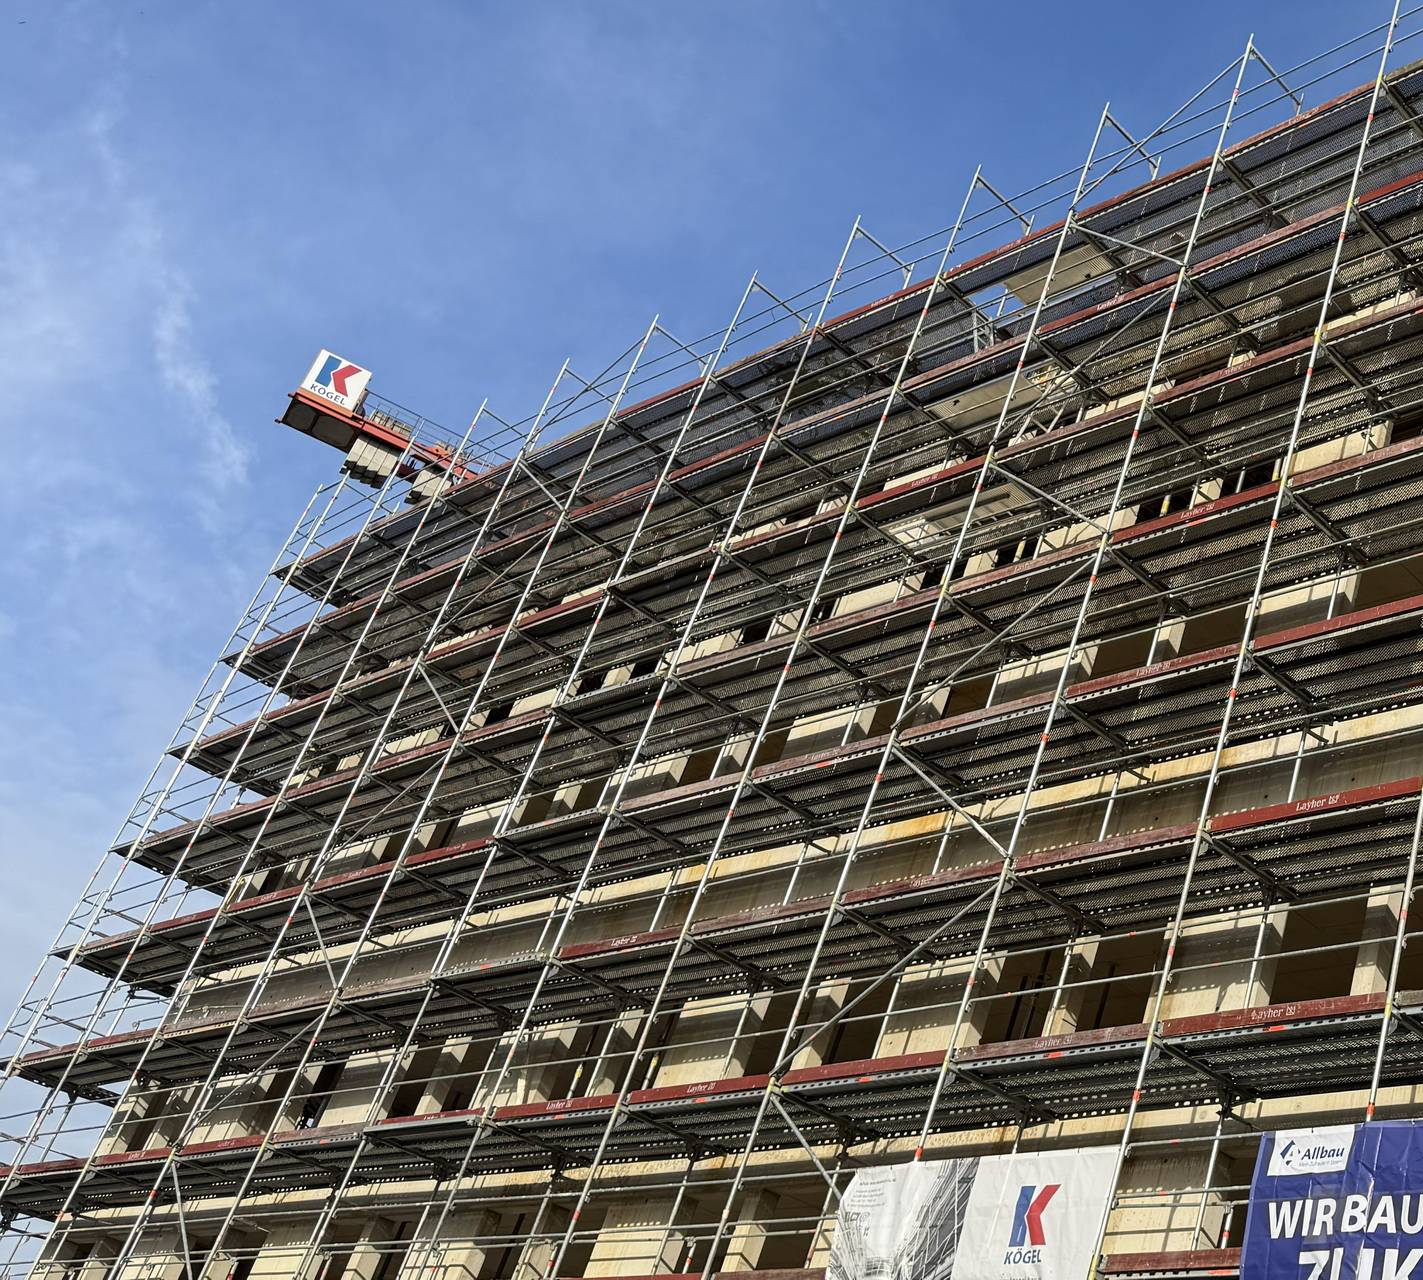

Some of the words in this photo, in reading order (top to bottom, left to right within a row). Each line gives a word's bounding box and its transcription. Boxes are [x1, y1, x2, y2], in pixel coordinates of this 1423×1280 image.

[1181, 506, 1205, 519] Layher
[1296, 797, 1326, 812] Layher
[1251, 1006, 1284, 1021] Layher
[687, 1083, 708, 1094] Layher
[1301, 1145, 1345, 1161] Allbau
[1268, 1198, 1337, 1239] WIR
[1003, 1247, 1042, 1265] KÖGEL
